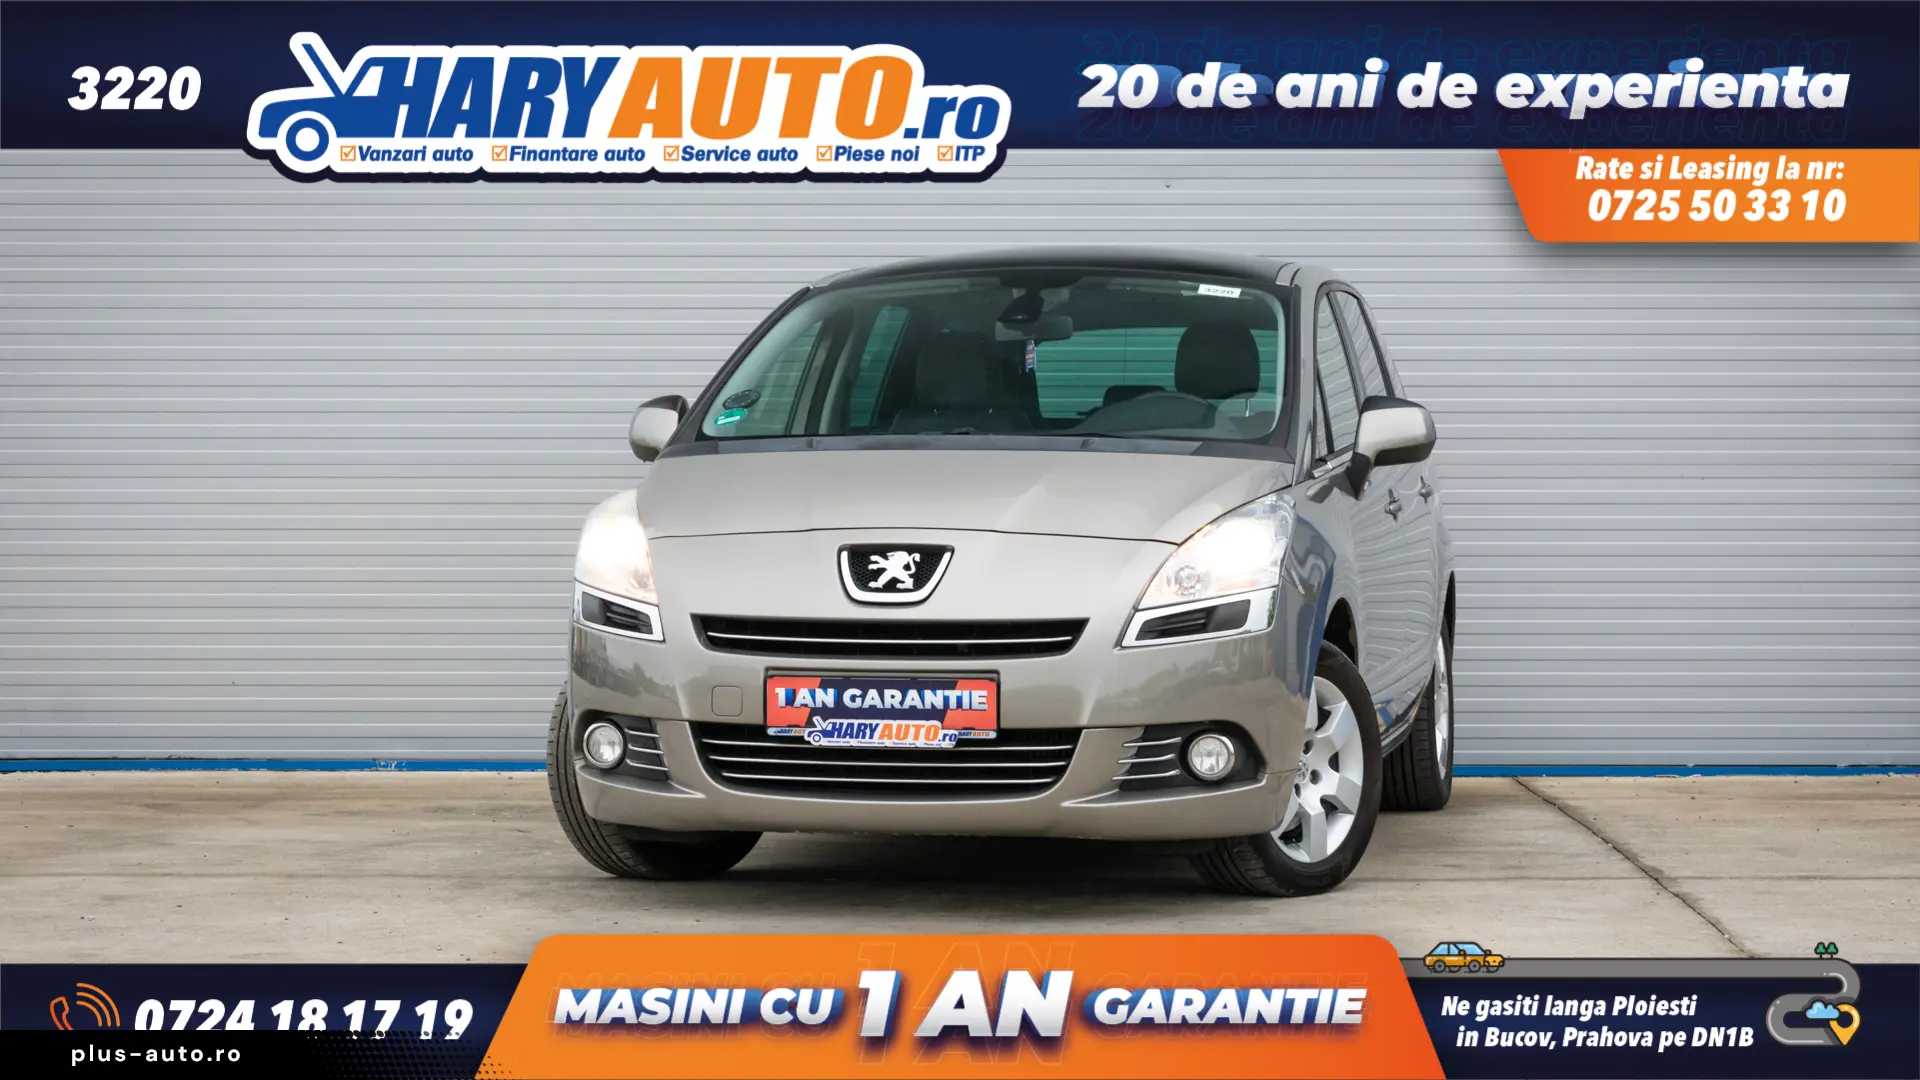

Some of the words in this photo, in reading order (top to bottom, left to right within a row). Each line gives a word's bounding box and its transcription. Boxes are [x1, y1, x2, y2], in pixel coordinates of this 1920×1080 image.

[775, 687, 787, 707] 1
[793, 688, 835, 708] AN
[843, 689, 989, 710] GARANTIE
[832, 721, 958, 743] HARYAUTO.ro
